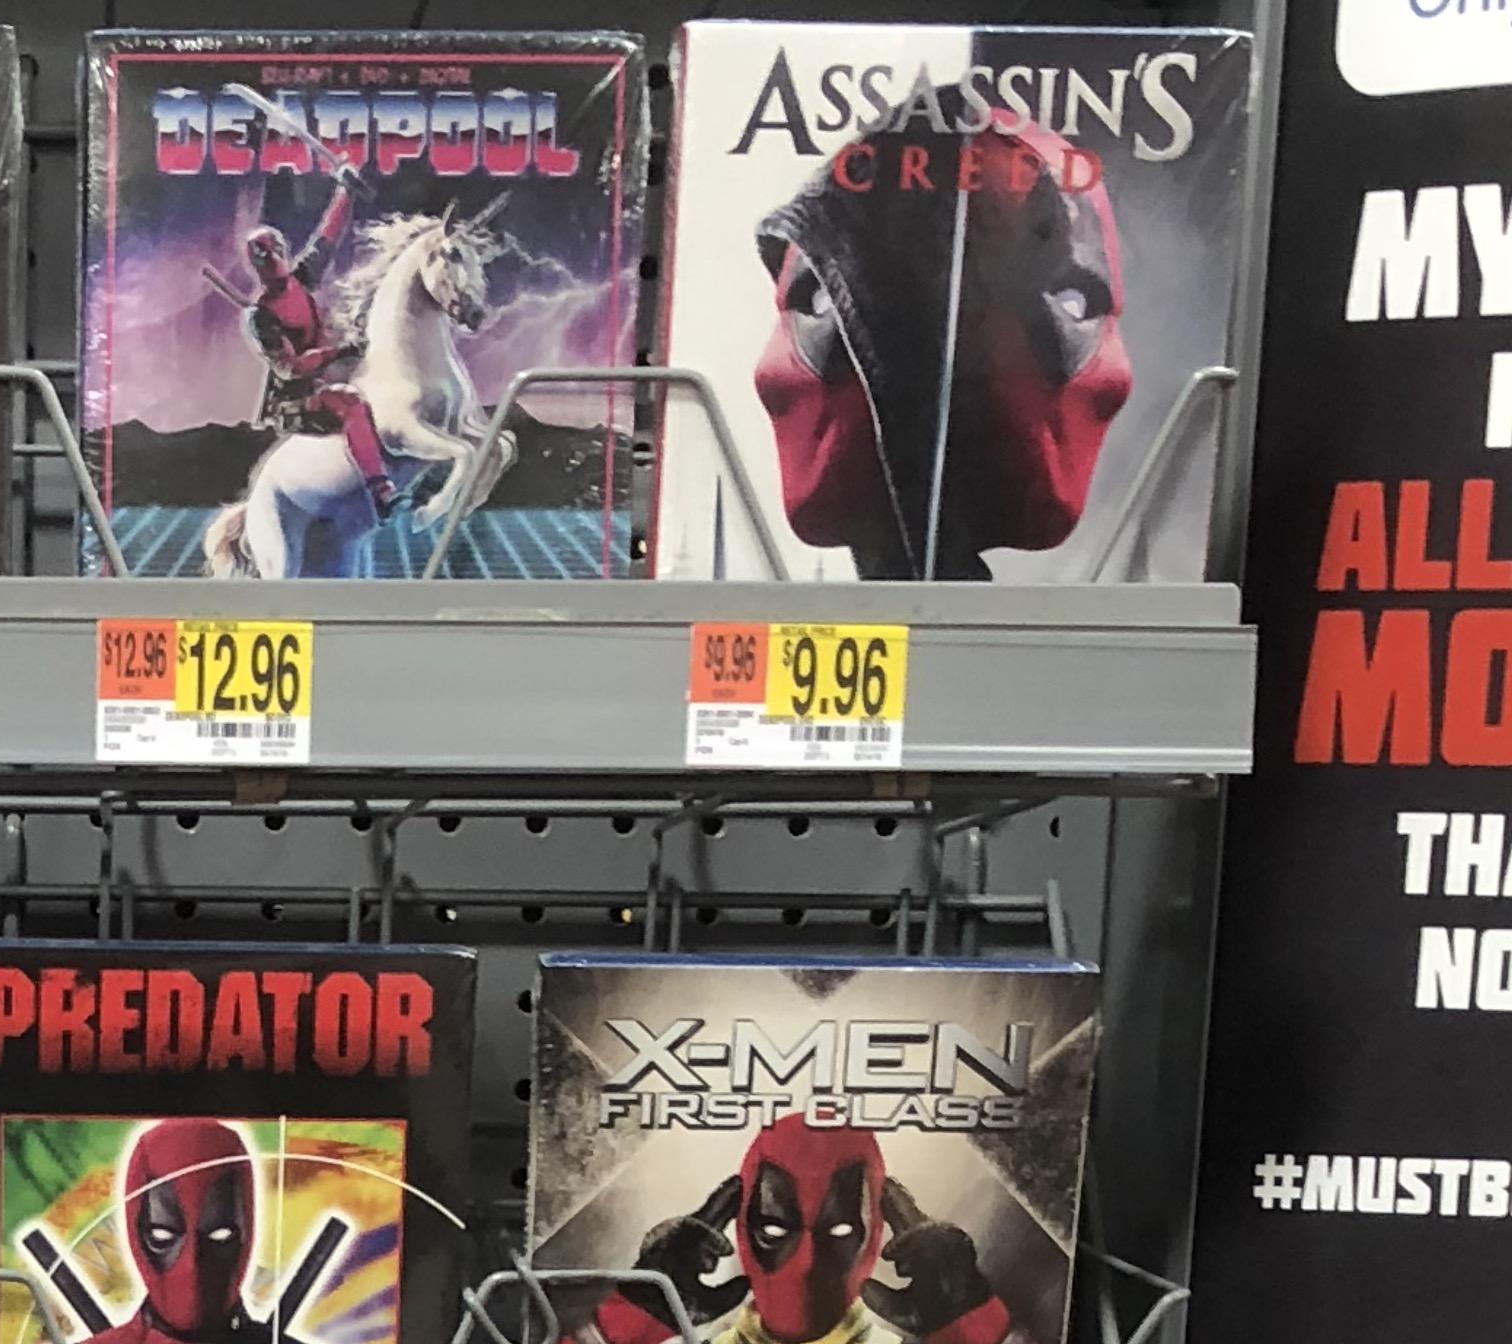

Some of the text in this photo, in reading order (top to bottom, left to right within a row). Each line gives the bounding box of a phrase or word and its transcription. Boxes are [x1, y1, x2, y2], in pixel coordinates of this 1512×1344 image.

[152, 87, 580, 176] DEADPOOL
[728, 45, 1196, 161] ASSASSIN'S
[833, 145, 1104, 195] CREED
[1345, 183, 1512, 322] MY
[1317, 478, 1512, 592] ALL
[104, 632, 166, 678] $12.96
[178, 632, 300, 712] $12.96
[705, 635, 756, 682] $9.96
[782, 636, 889, 716] $9.96
[1396, 812, 1512, 896] TH
[597, 1017, 1034, 1096] X-MEN
[599, 1092, 1025, 1133] FIRST CLASS
